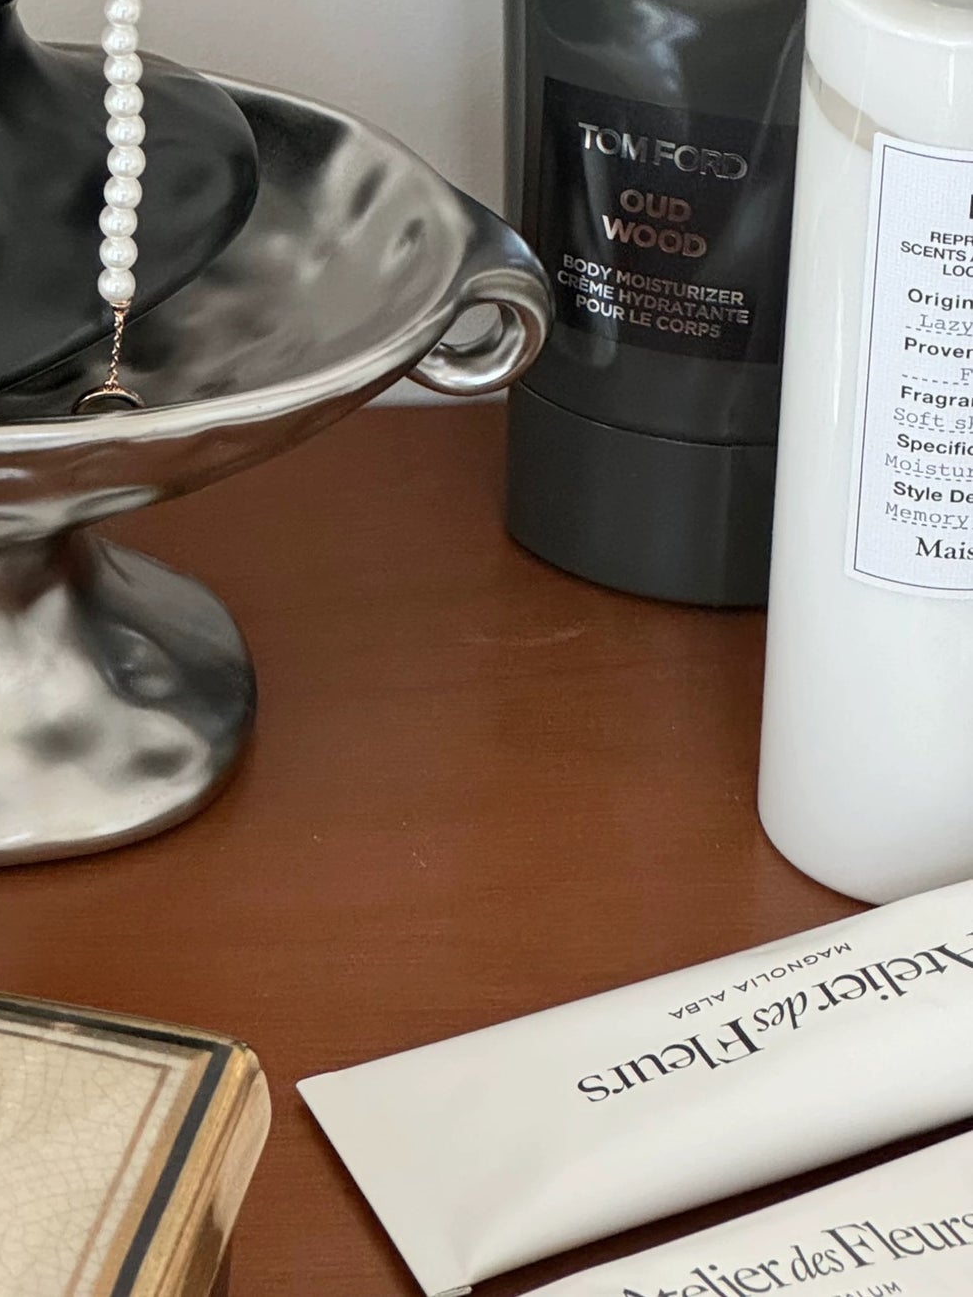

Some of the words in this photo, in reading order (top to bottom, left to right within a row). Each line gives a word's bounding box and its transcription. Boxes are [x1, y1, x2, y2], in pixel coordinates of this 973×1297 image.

[578, 122, 648, 163] TOM
[653, 139, 748, 180] FORD
[619, 188, 692, 223] OUD
[602, 214, 707, 258] WOOD
[900, 240, 967, 262] SCENTS
[557, 269, 614, 300] CRÈME
[619, 289, 750, 324] HYDRATANTE
[563, 253, 612, 281] BODY
[616, 269, 744, 306] MOISTURIZER
[908, 288, 973, 311] Origin
[576, 294, 625, 321] POUR
[629, 309, 653, 327] LE
[656, 315, 721, 339] CORPS
[920, 314, 973, 336] Lazy
[893, 407, 944, 428] Soft
[901, 385, 973, 409] Fragra
[893, 481, 943, 502] Style
[885, 502, 969, 529] Memory
[733, 942, 852, 992] MAGNOLIA
[812, 932, 973, 1011] Atelier
[668, 989, 726, 1020] ALBA
[753, 990, 808, 1031] des
[577, 1016, 765, 1102] Fleurs
[623, 1258, 793, 1297] elier
[790, 1244, 846, 1282] des
